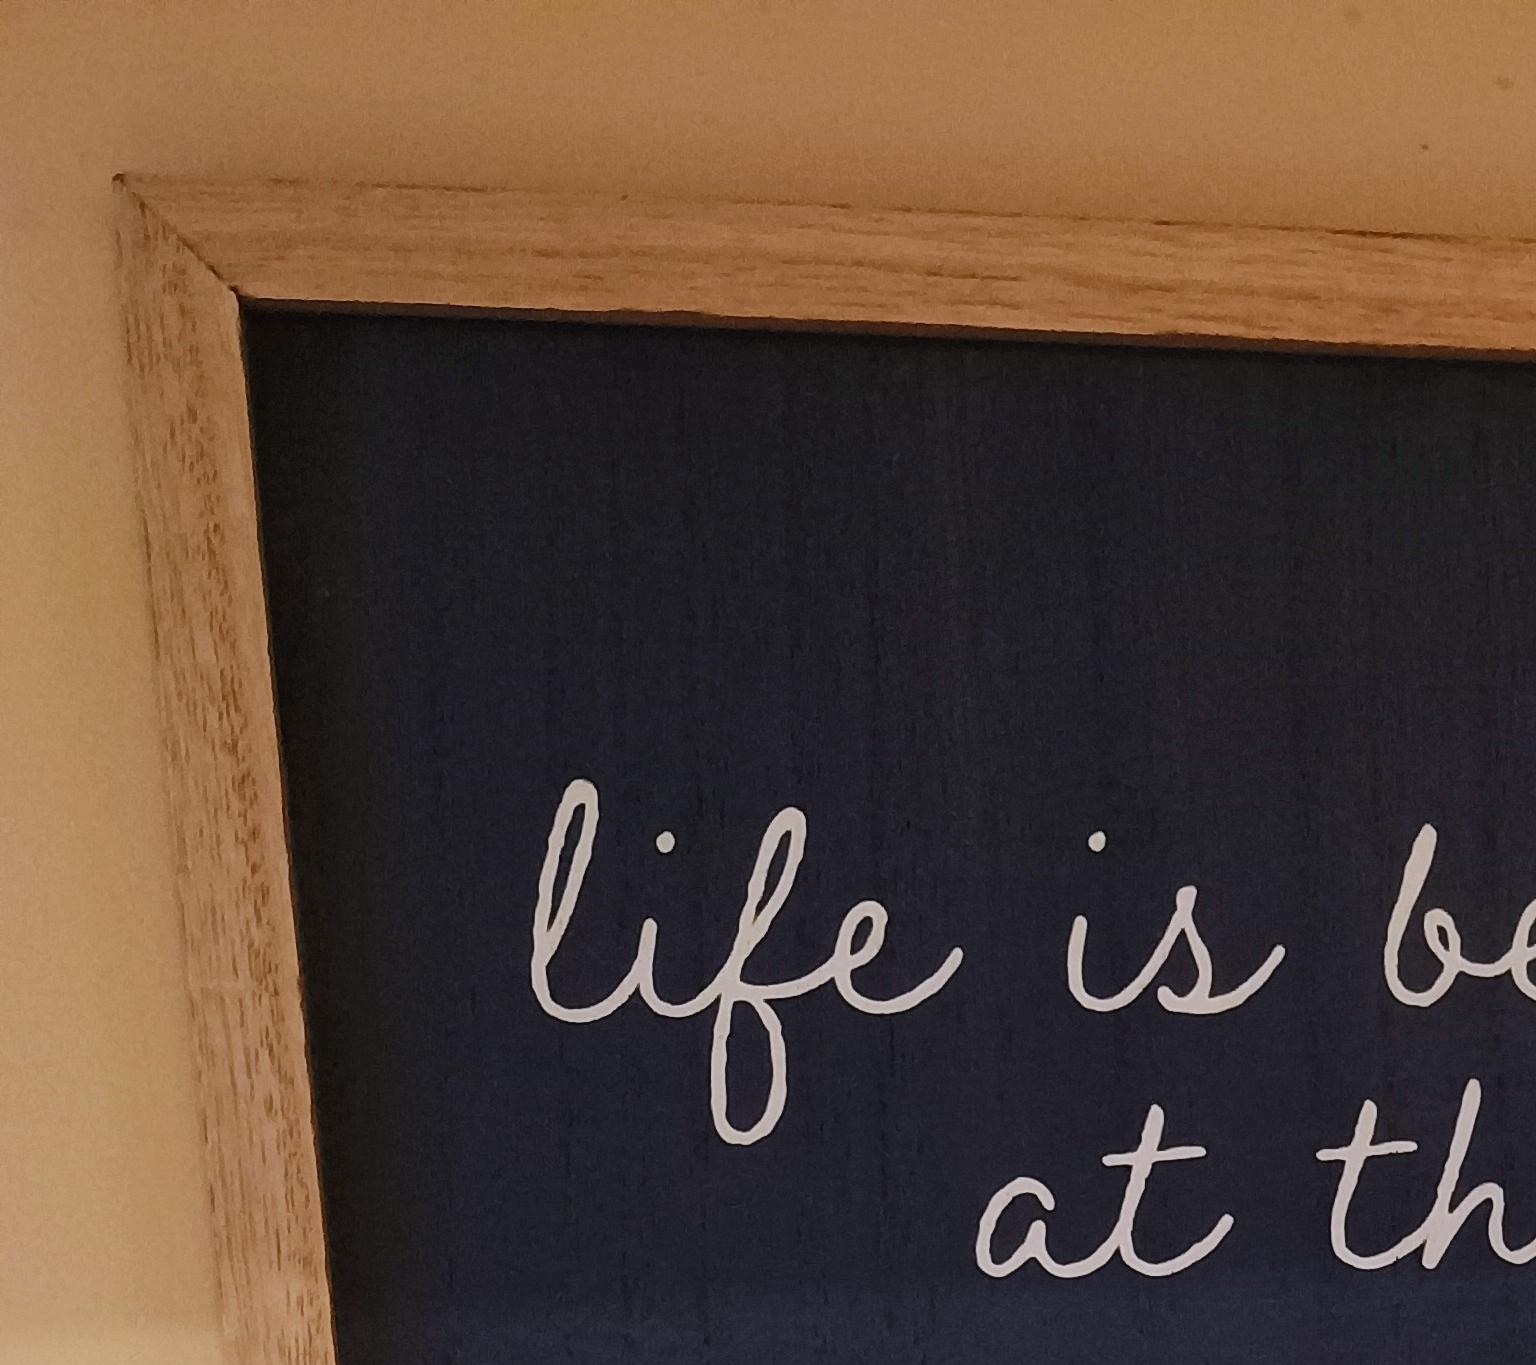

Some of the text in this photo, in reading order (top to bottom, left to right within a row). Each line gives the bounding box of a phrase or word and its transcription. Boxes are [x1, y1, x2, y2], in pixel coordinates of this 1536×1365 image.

[529, 777, 965, 1146] life
[1068, 829, 1286, 1016] is
[973, 1102, 1234, 1279] at
